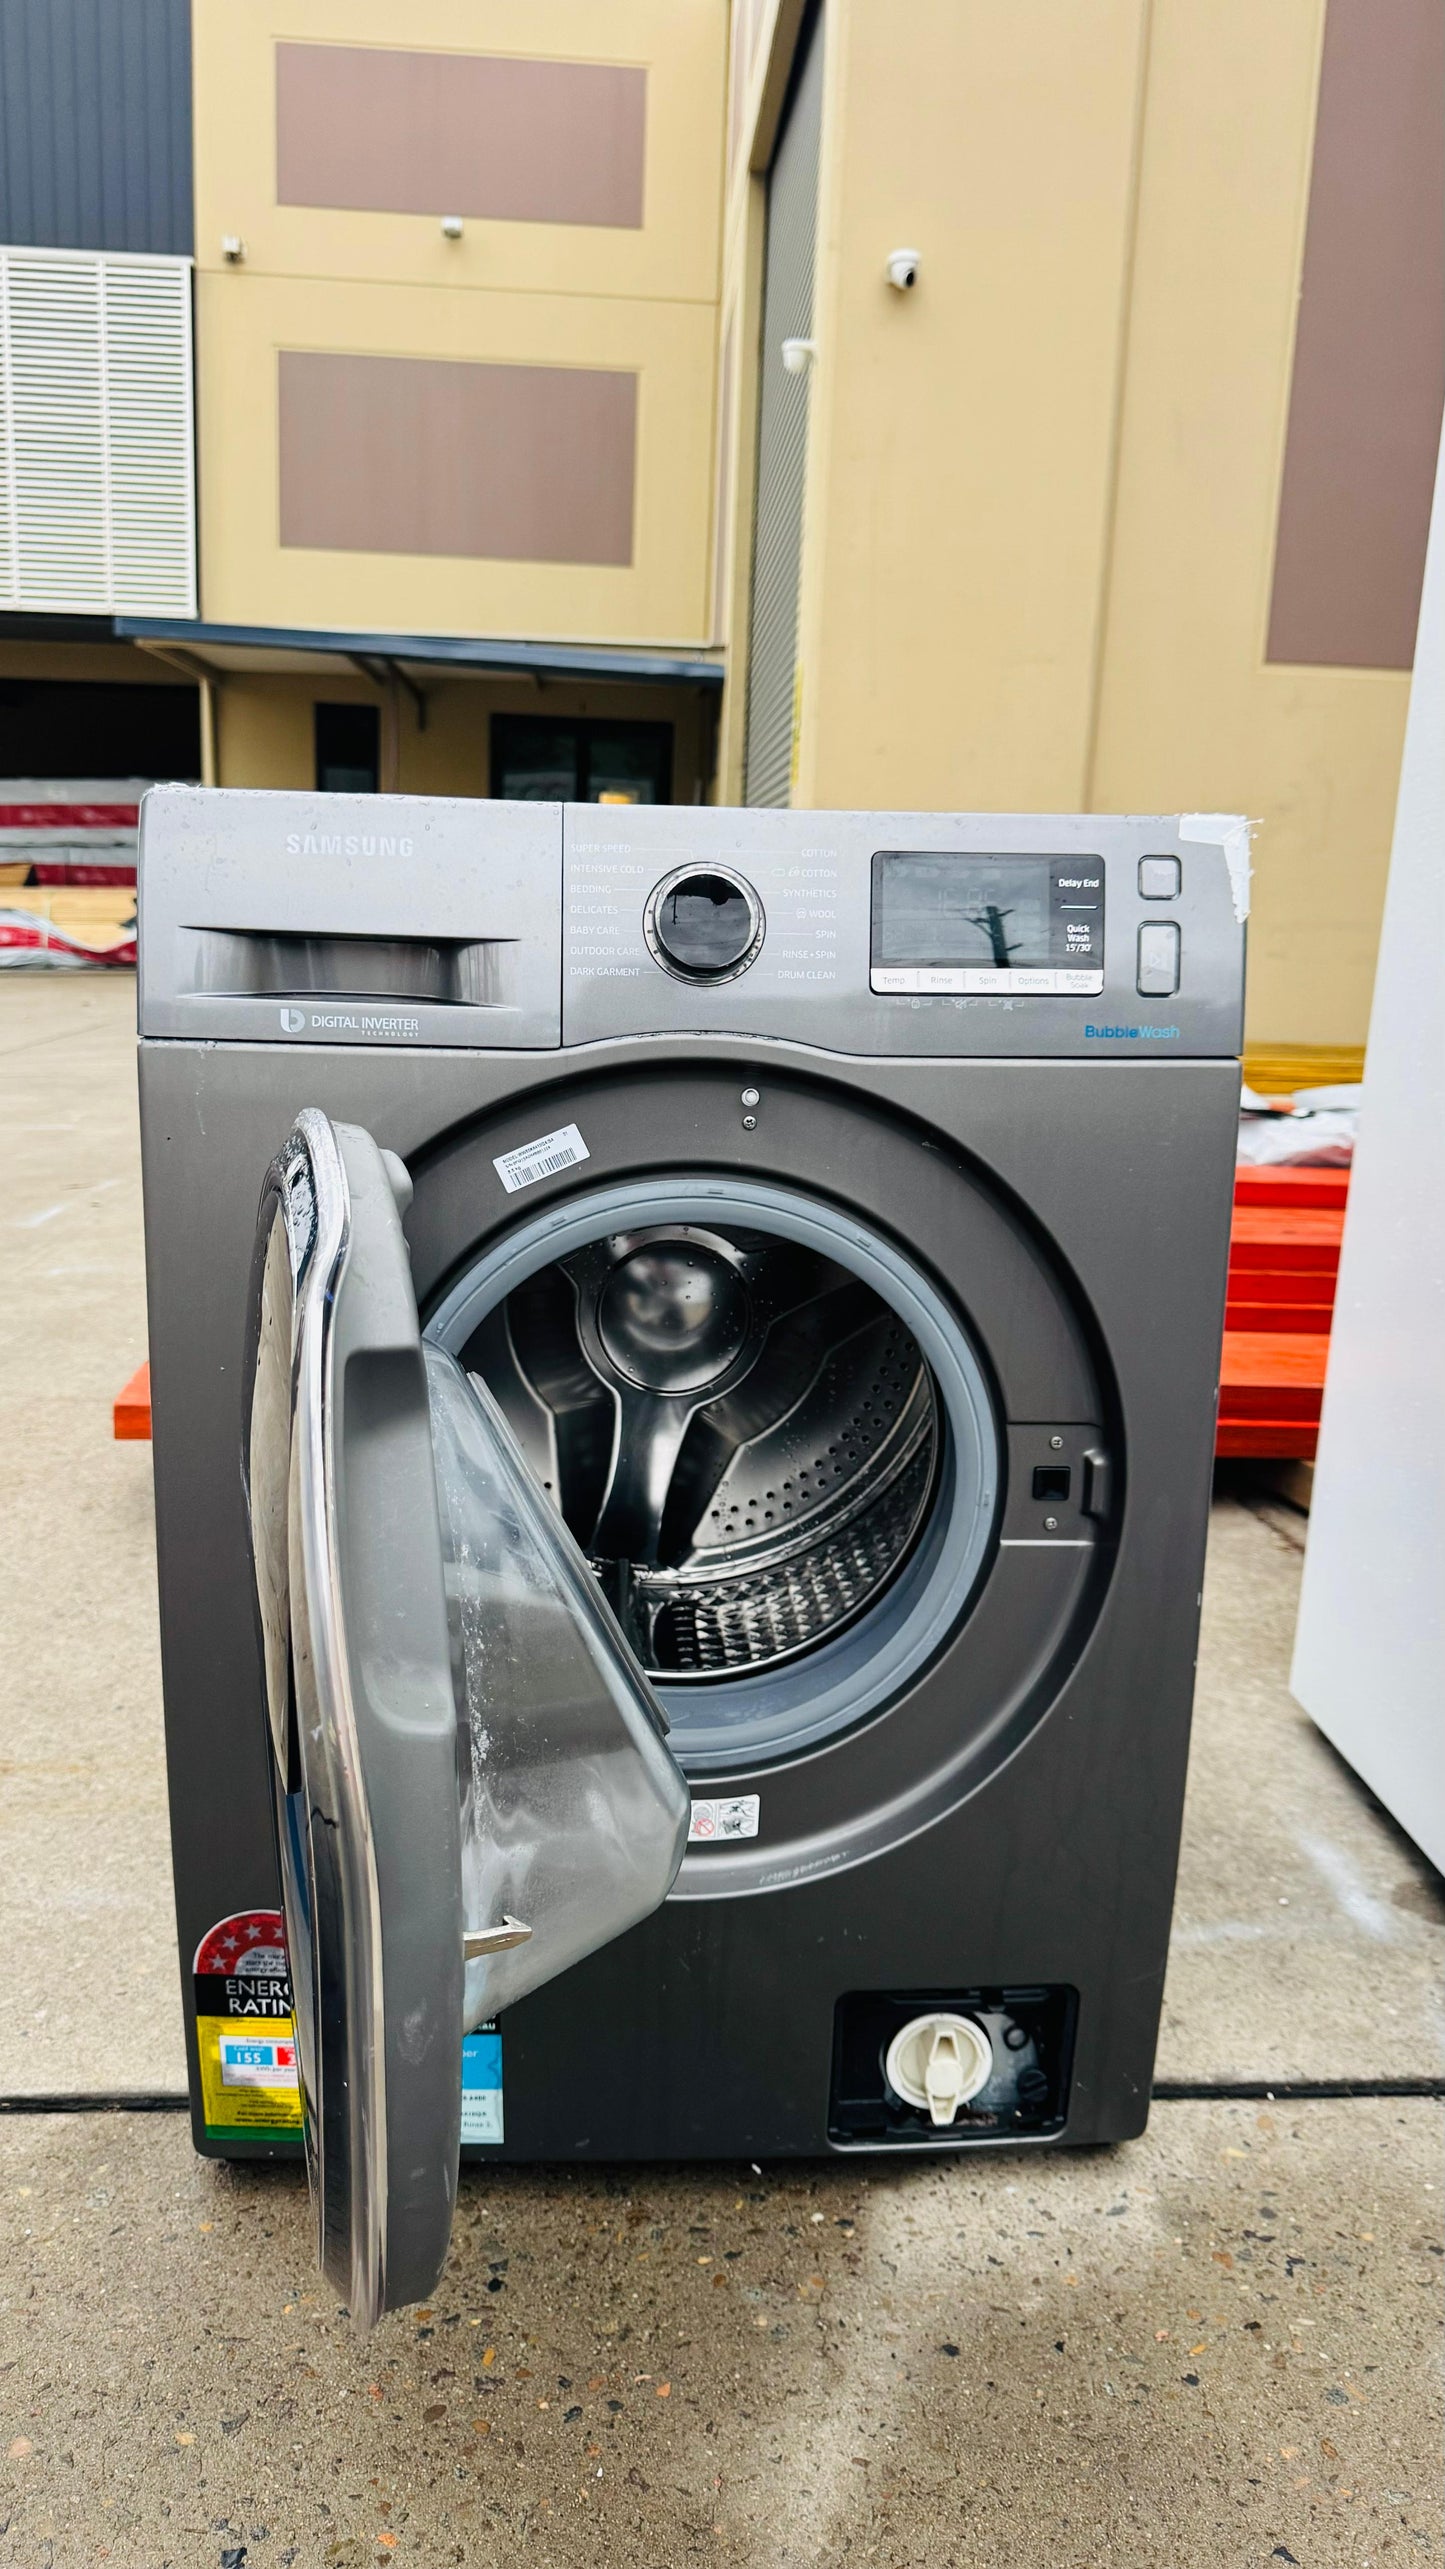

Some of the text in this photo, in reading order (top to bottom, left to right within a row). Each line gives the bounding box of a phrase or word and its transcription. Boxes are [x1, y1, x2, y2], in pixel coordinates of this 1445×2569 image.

[286, 834, 414, 857] SAMSUNG
[571, 844, 631, 853] SUPER SPEED
[801, 848, 837, 858] COTTON
[570, 863, 644, 874] INTENSIVE COLD
[801, 868, 838, 878] COTTON
[1058, 878, 1100, 889] Delay End
[570, 884, 612, 894] BEDDING
[783, 888, 837, 898] SYNTHETICS
[570, 905, 619, 915] DELICATES
[808, 909, 837, 919] WOOL
[570, 925, 620, 935] BABY CARE
[815, 929, 837, 939] SPIN
[1066, 924, 1090, 934] Quick
[1067, 934, 1090, 943] Wash
[570, 946, 640, 956] OUTDOOR CARE
[782, 950, 809, 959] RINSE
[815, 950, 837, 959] SPIN
[570, 967, 640, 977] DARK GARMENT
[777, 970, 837, 980] DRUM CLEAN
[930, 975, 953, 985] Rinse
[978, 976, 997, 986] Spin
[1017, 975, 1050, 986] Options
[311, 1015, 419, 1030] DIGITAL INVERTER
[237, 2051, 262, 2064] 155
